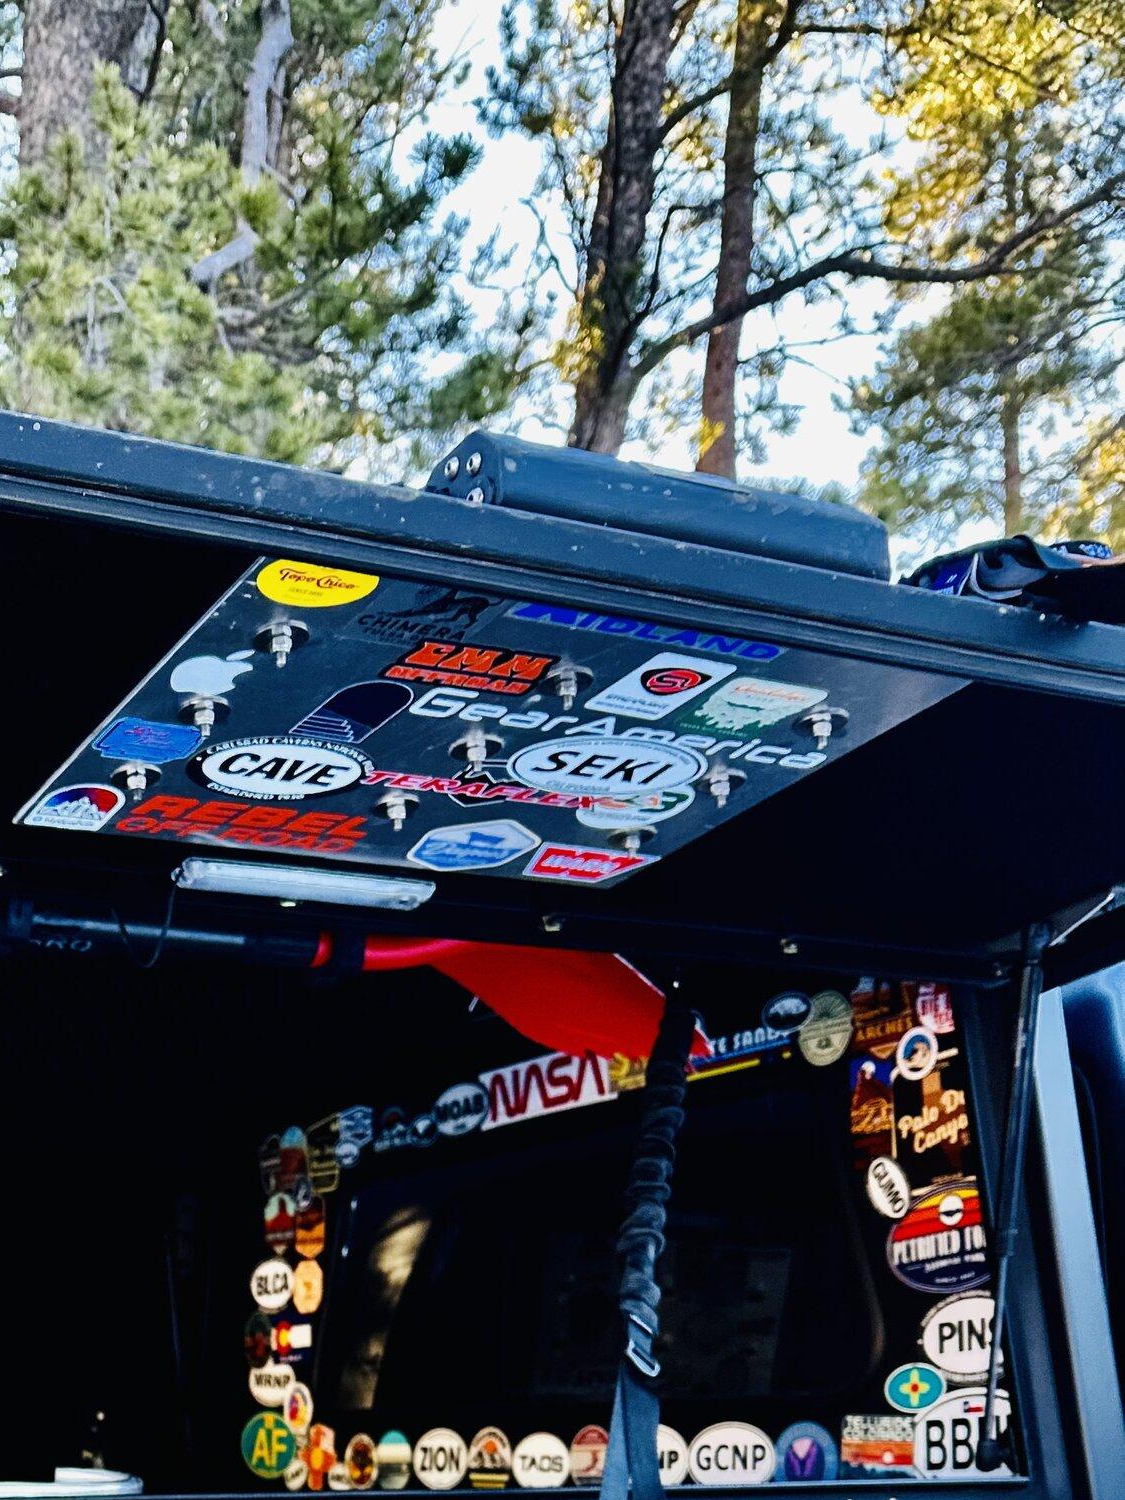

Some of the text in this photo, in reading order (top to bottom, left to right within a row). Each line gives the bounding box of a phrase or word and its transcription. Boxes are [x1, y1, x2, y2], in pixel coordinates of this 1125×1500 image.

[279, 567, 356, 589] Topo Chico
[357, 612, 467, 643] CHIMERA
[218, 753, 352, 787] CAVE
[531, 751, 673, 785] SEKI
[359, 769, 595, 811] TERAFLEX
[130, 794, 368, 840] REBEL
[217, 827, 357, 853] ROAD
[488, 1049, 606, 1122] NASA
[897, 1104, 940, 1139] Palo
[419, 1446, 461, 1472] ZION
[518, 1455, 564, 1473] TAOS
[695, 1443, 767, 1471] GCNP
